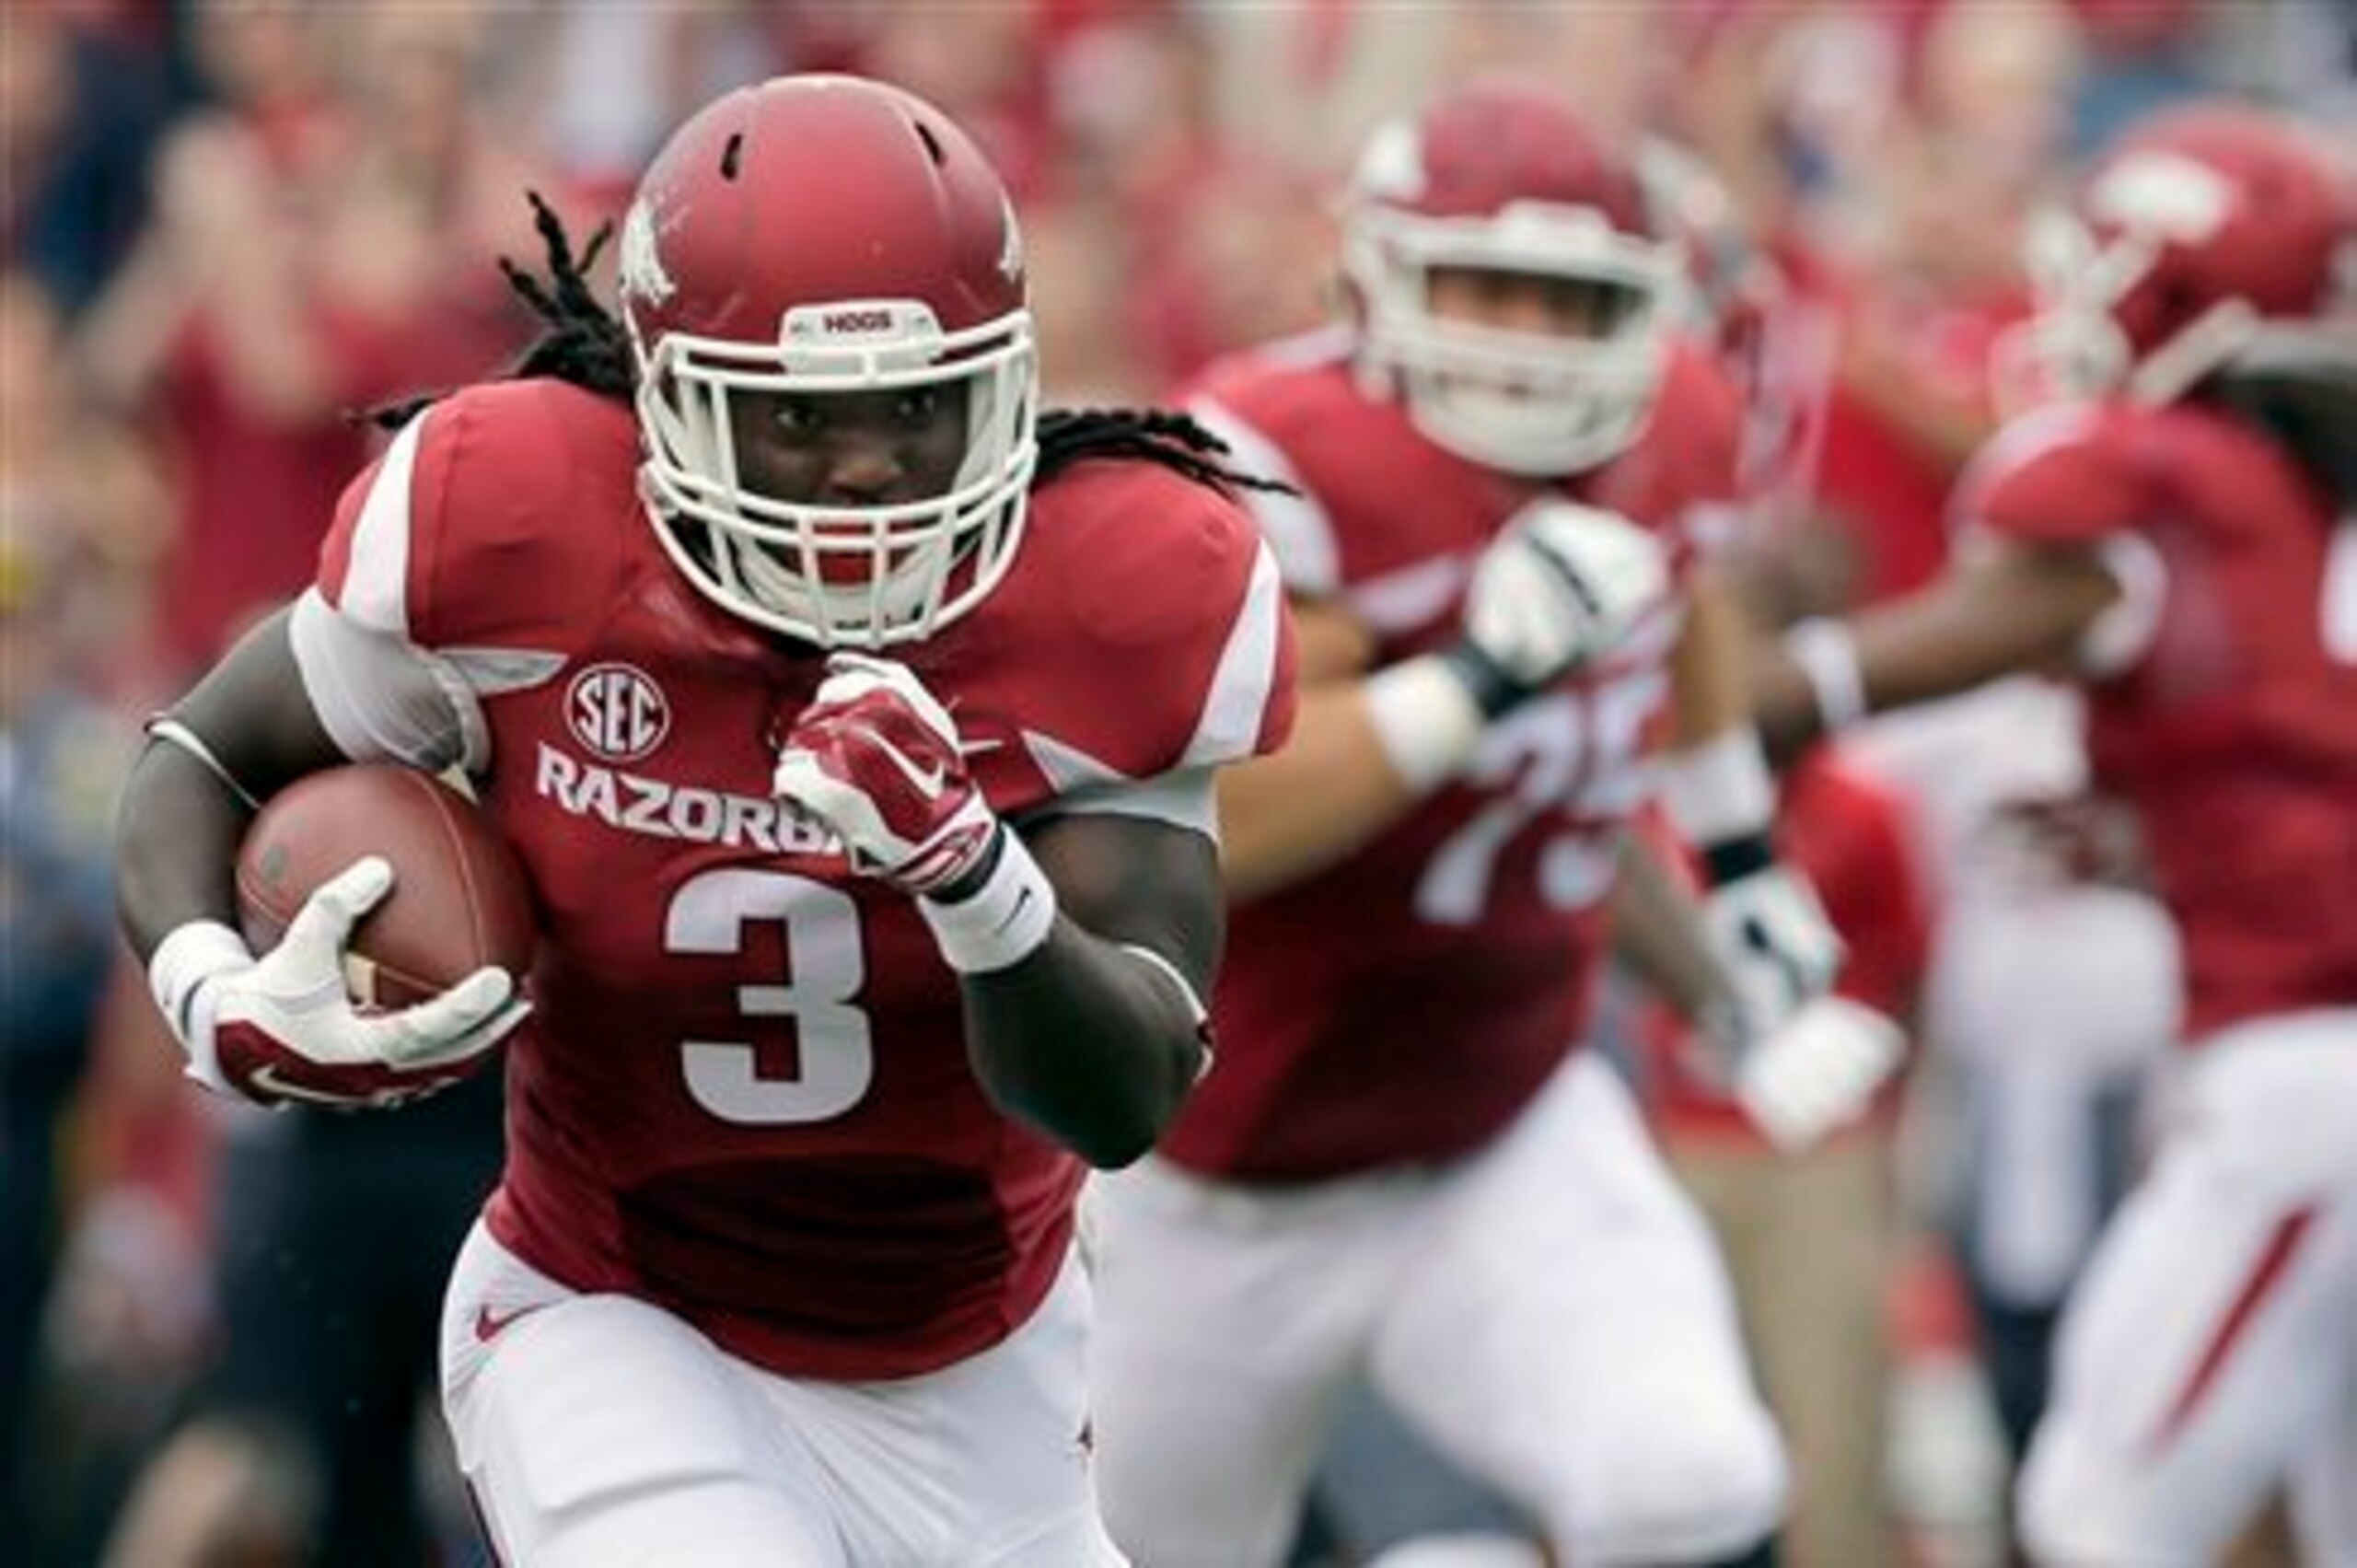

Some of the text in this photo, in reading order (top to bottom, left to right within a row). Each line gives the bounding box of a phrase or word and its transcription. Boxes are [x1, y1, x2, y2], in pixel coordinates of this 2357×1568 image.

[823, 310, 892, 332] HOGS
[575, 673, 657, 753] SEC
[536, 741, 842, 855] RAZORB
[665, 868, 874, 1124] 3
